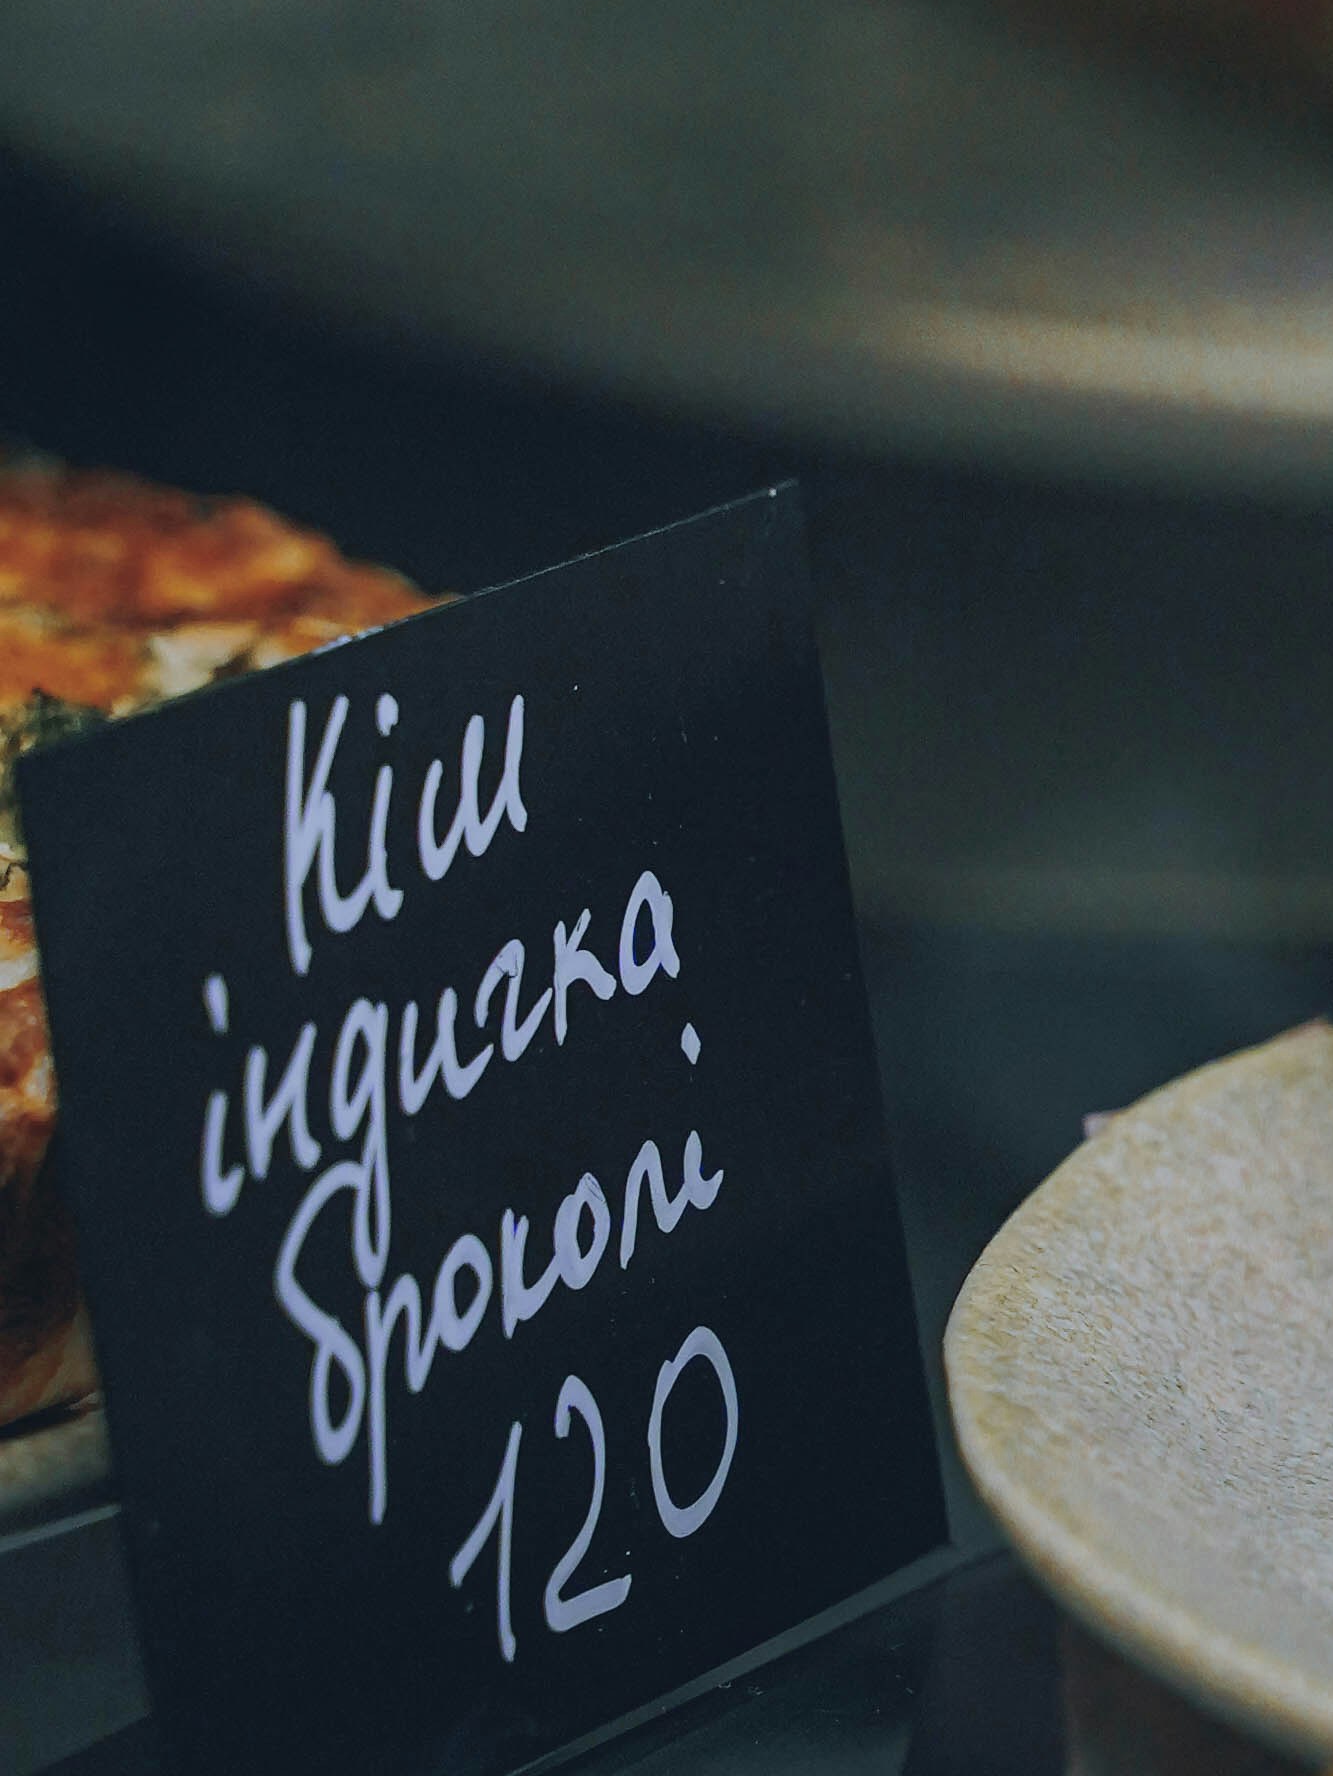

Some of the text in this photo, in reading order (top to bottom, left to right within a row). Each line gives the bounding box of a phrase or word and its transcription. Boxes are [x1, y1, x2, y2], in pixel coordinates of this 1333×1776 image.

[284, 693, 529, 977] Кіш
[274, 1021, 726, 1526] броколі
[450, 1325, 740, 1662] 120
